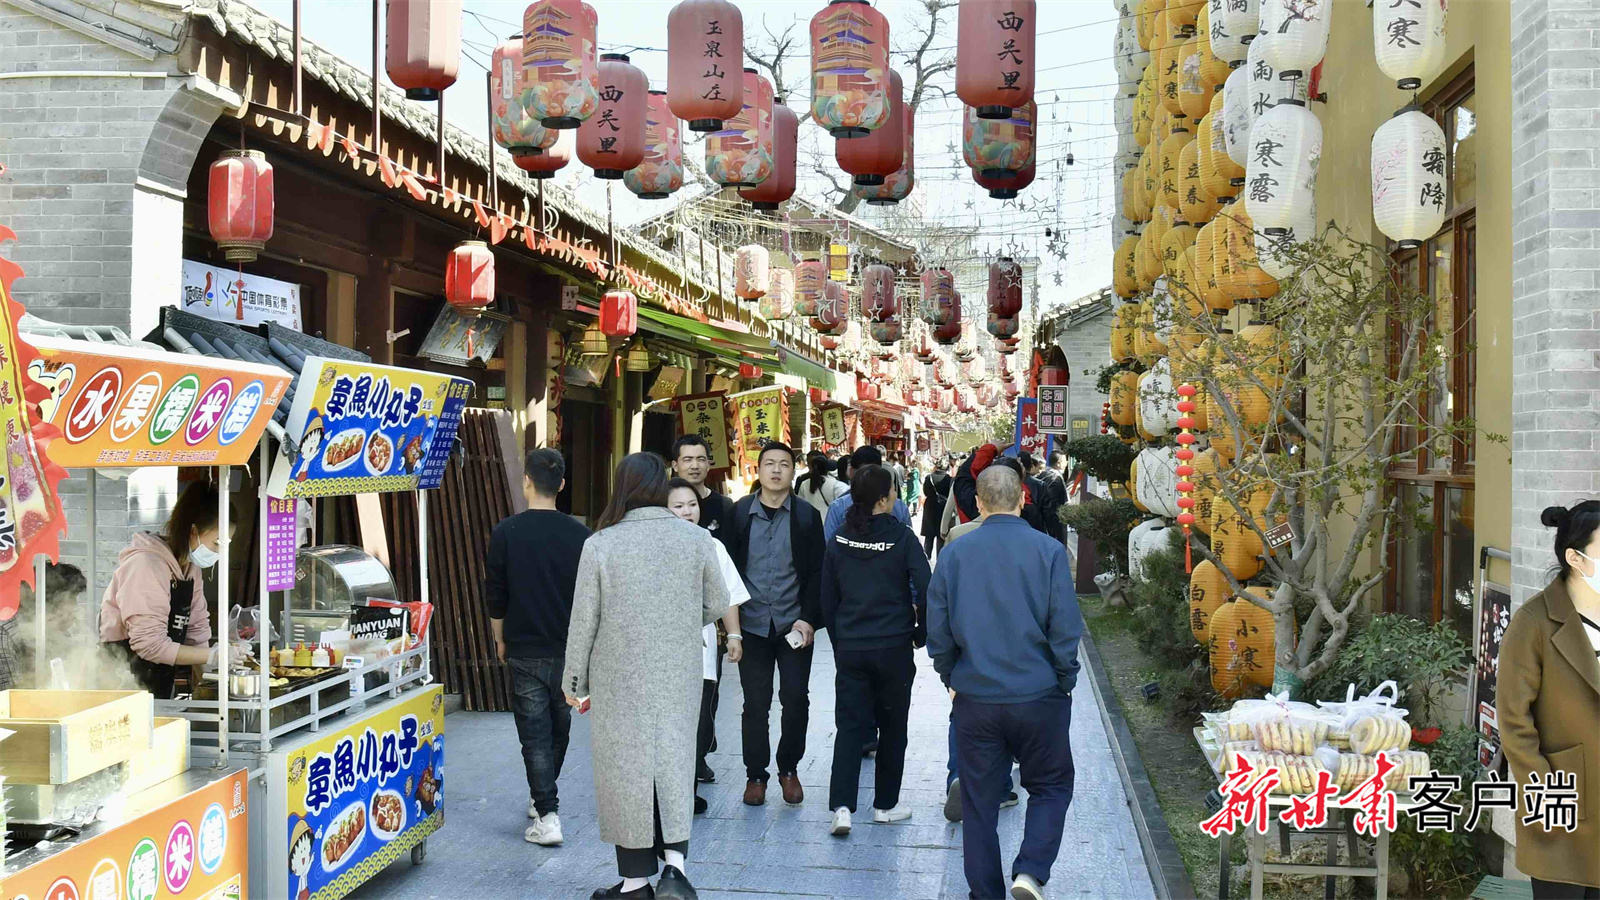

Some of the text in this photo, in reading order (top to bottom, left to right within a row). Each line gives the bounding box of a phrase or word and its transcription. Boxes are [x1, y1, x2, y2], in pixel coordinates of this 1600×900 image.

[701, 20, 727, 103] 玉泉山庄
[996, 11, 1024, 92] 西关里
[1253, 59, 1280, 115] 雨水
[596, 85, 624, 155] 西关里
[1184, 162, 1206, 206] 立春
[1249, 138, 1284, 203] 寒露
[1420, 146, 1446, 214] 霜降
[72, 379, 260, 434] 水果糯米糕
[448, 382, 470, 400] 价目表
[270, 499, 294, 514] 价目表
[1191, 583, 1209, 631] 白露
[1236, 619, 1263, 672] 小寒
[57, 813, 225, 900] 果糯米糕
